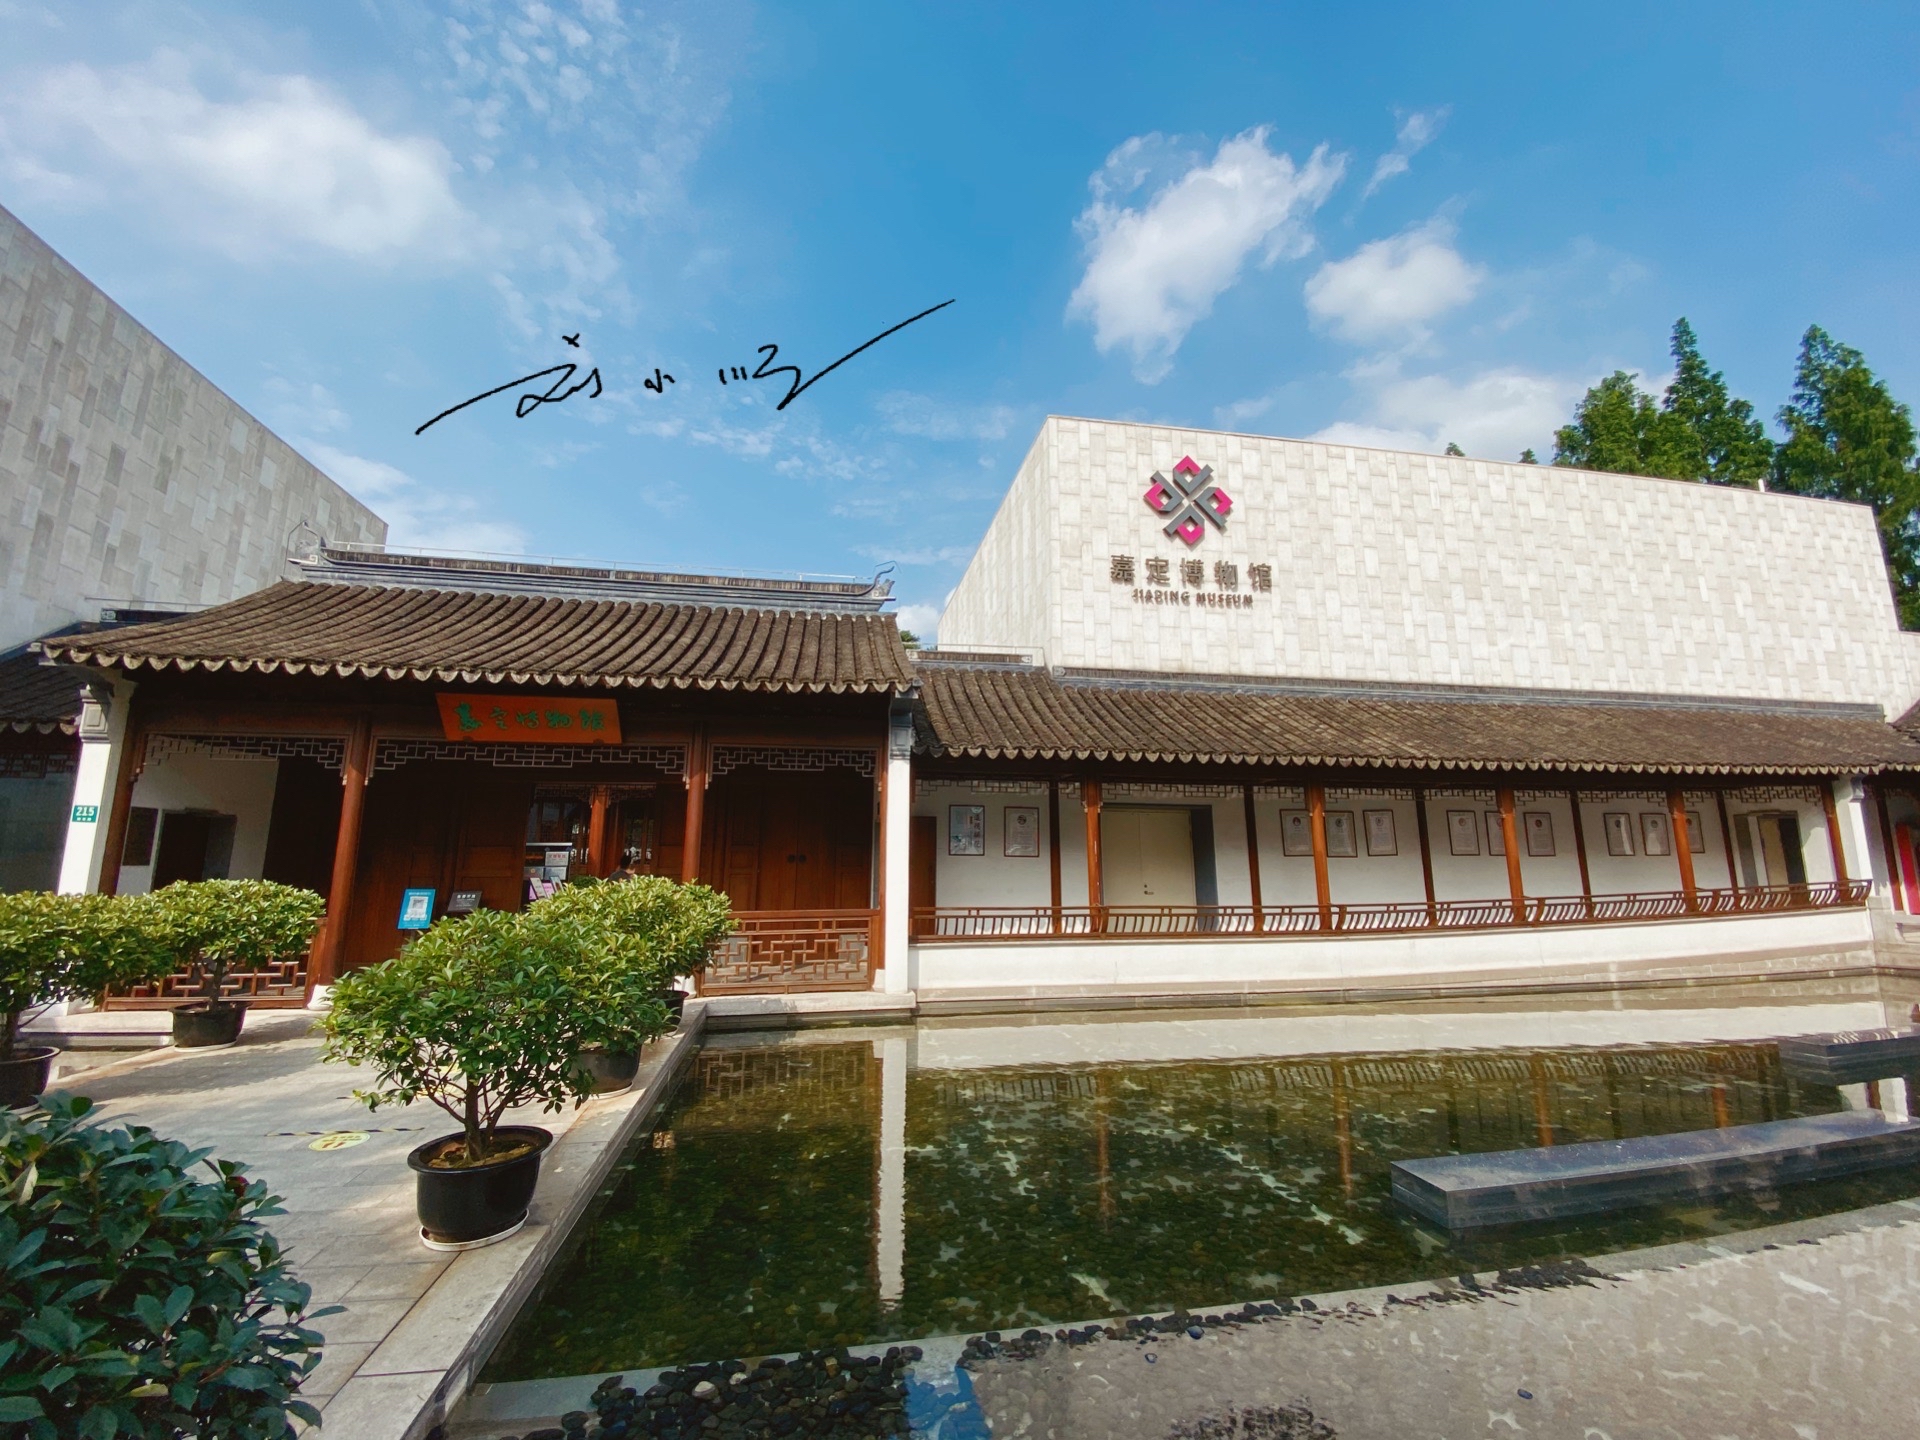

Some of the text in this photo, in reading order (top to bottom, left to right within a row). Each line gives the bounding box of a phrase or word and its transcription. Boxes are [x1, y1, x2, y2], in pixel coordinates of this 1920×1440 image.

[1110, 554, 1273, 593] 嘉定博物馆
[1132, 588, 1254, 609] JIADING MUSEUM
[75, 806, 95, 816] 215
